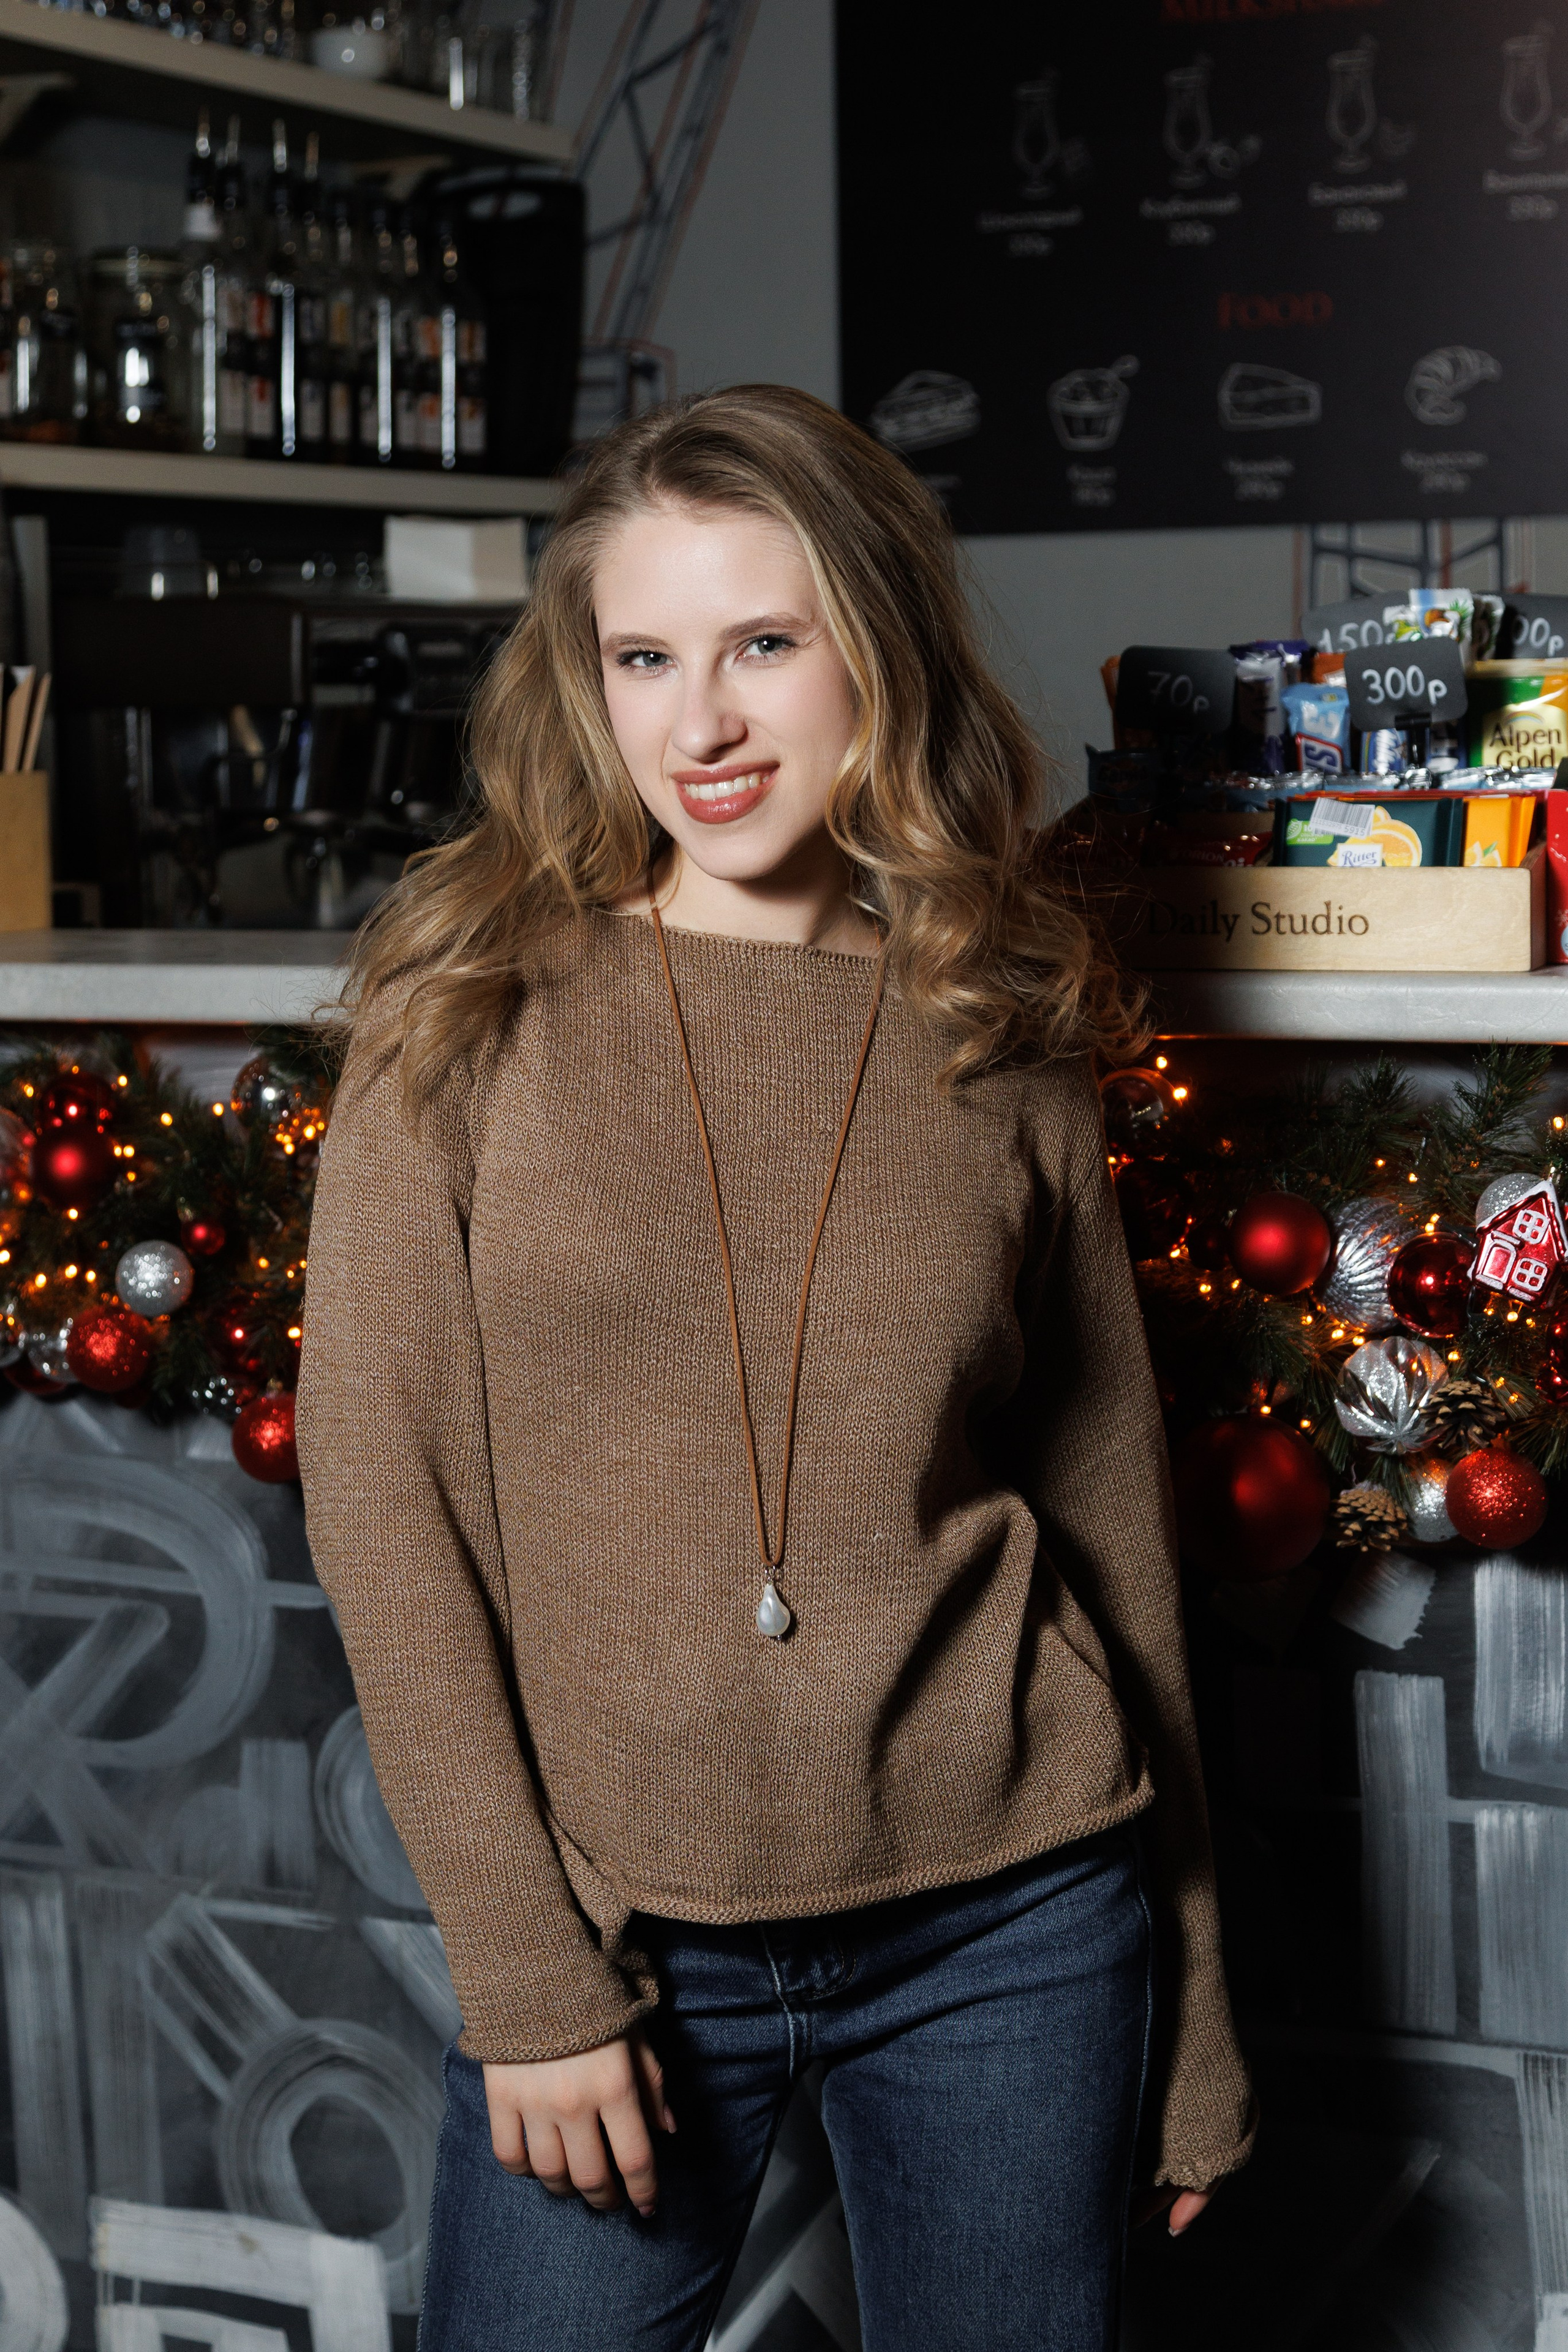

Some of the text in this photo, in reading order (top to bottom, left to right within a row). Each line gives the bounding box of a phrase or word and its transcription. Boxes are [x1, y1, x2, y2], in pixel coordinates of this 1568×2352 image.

[1488, 723, 1562, 753] Alpen
[1496, 746, 1556, 770] Gold
[1344, 825, 1366, 837] 5915
[1341, 850, 1378, 867] Ritter
[1147, 900, 1370, 943] Daily Studio
